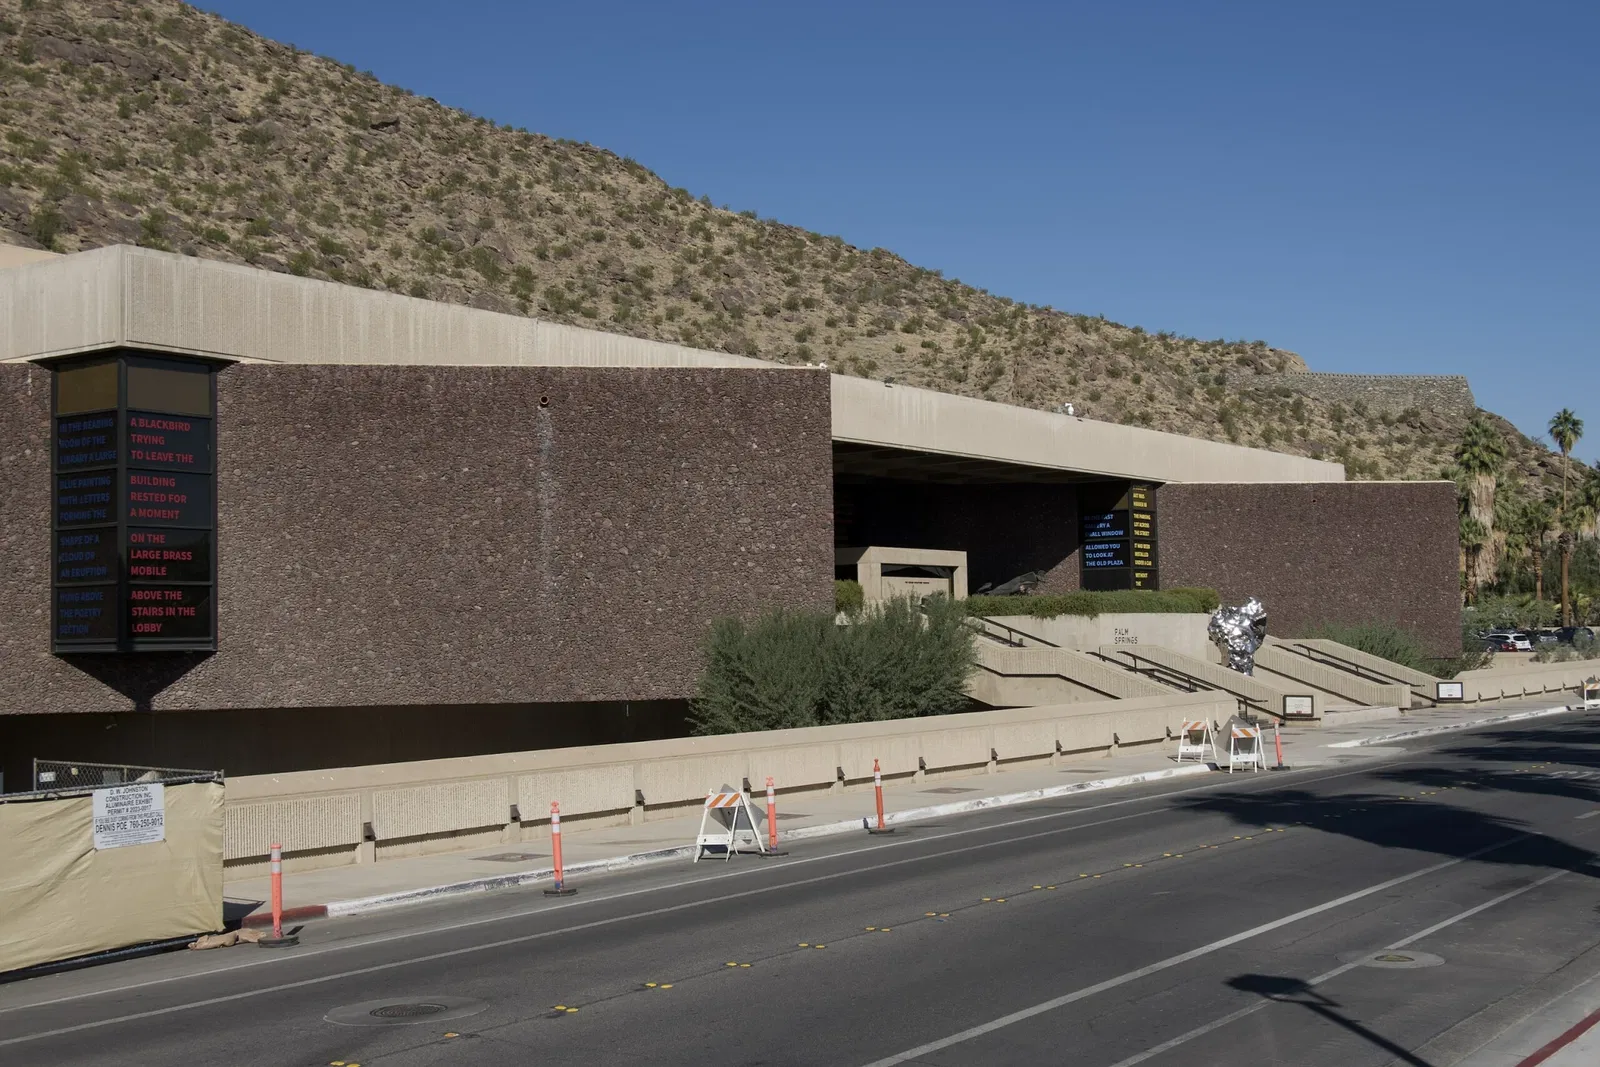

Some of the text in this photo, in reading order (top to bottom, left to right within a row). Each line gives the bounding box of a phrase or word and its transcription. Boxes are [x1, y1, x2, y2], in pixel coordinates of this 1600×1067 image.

[83, 418, 113, 430] READING
[130, 419, 191, 431] A BLACKBIRD
[82, 438, 91, 446] OF
[92, 436, 106, 445] THE
[131, 434, 165, 446] TRYING
[60, 454, 88, 464] LIBRARY
[95, 451, 117, 460] LARGE
[131, 450, 194, 463] TO LEAVE THE
[78, 476, 112, 488] PAINTING
[131, 475, 176, 487] BUILDING
[80, 492, 110, 504] LETTERS
[131, 492, 187, 504] RESTED FOR
[92, 509, 107, 519] THE
[130, 508, 180, 520] A MOMENT
[60, 536, 83, 546] SHAPE
[131, 534, 165, 544] ON THE
[131, 550, 192, 561] LARGE BRASS
[72, 566, 107, 577] ERUPTION
[131, 566, 167, 576] MOBILE
[81, 592, 104, 601] ABOVE
[131, 590, 183, 600] ABOVE THE
[132, 606, 195, 617] STAIRS IN THE
[132, 623, 162, 633] LOBBY
[105, 793, 142, 802] CONSTRUCTION
[105, 800, 134, 808] ALUMINAIRE
[95, 823, 115, 833] DENNIS
[116, 821, 127, 830] POE
